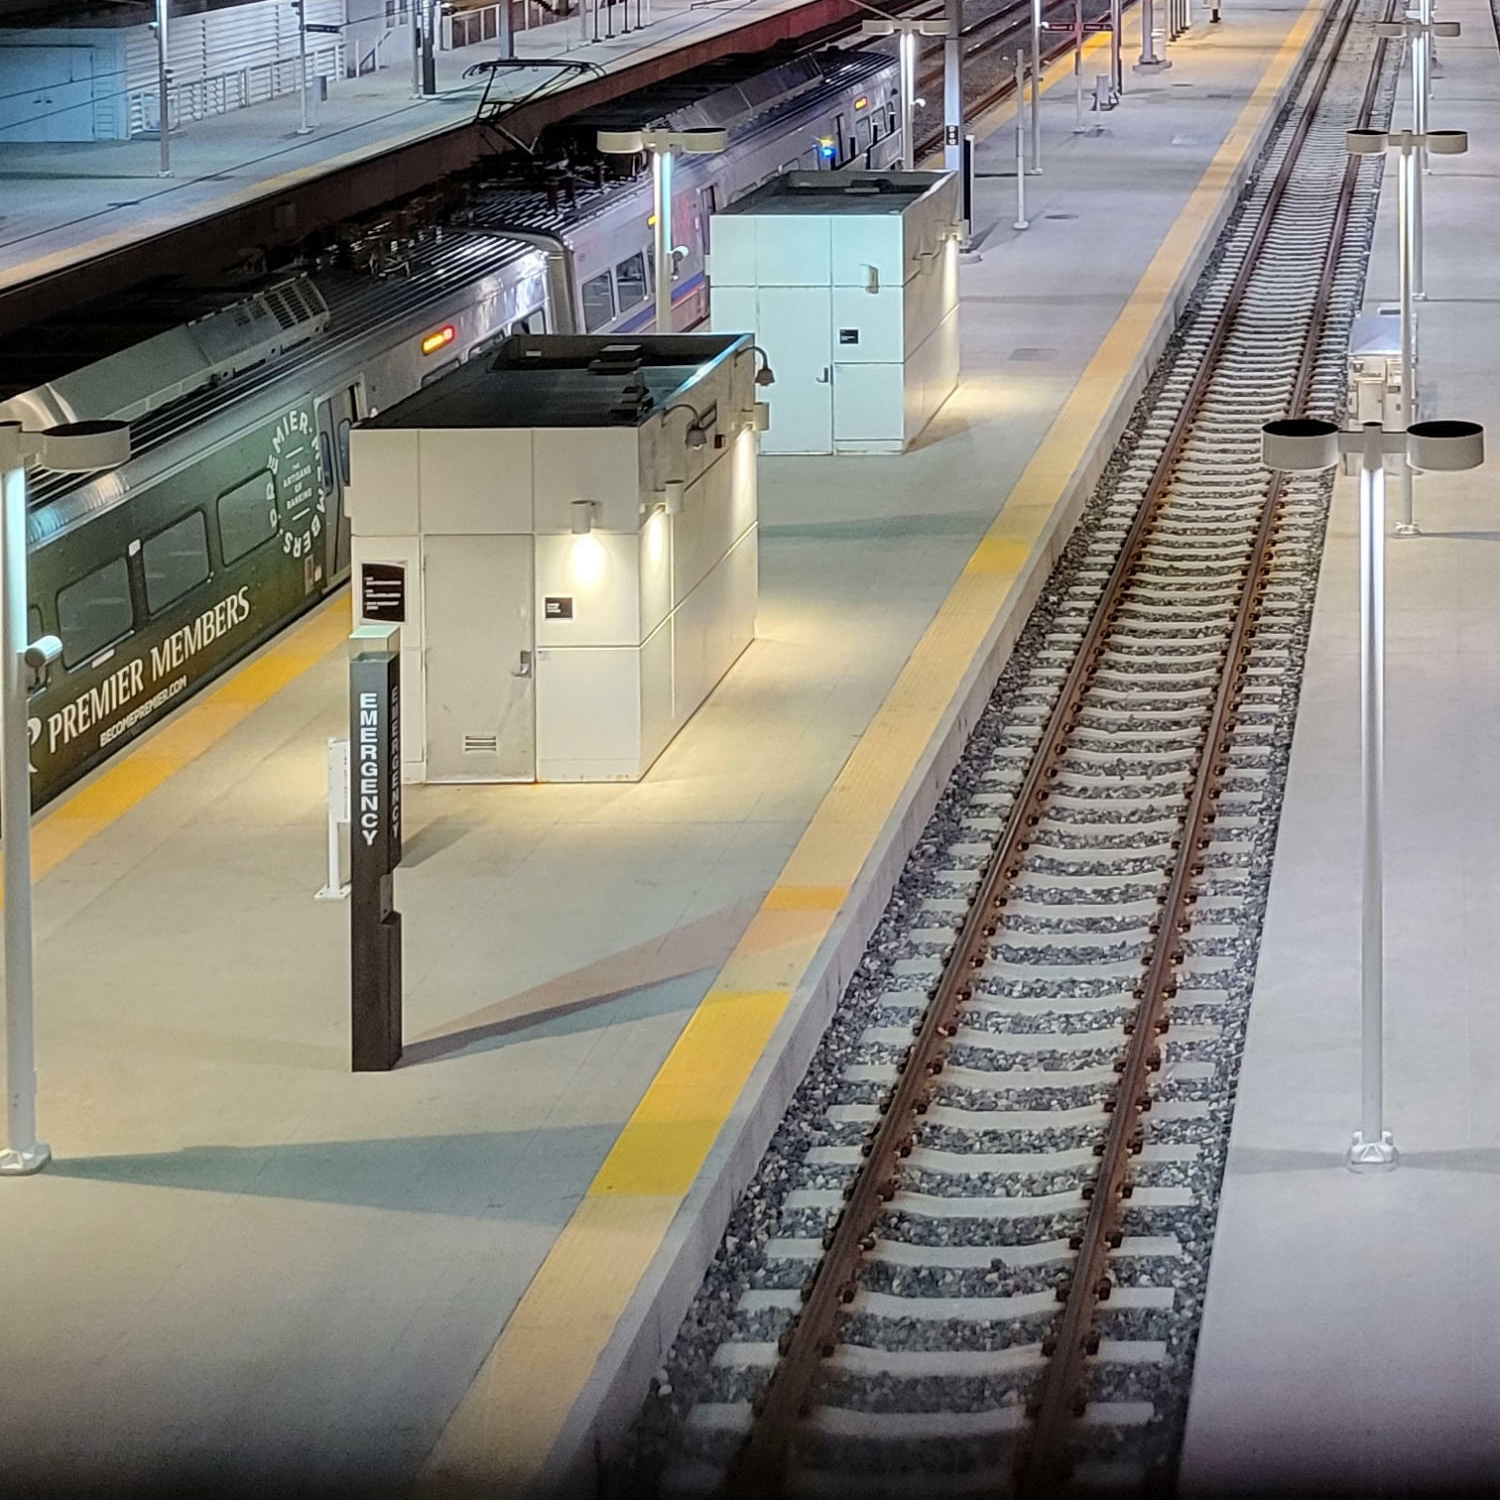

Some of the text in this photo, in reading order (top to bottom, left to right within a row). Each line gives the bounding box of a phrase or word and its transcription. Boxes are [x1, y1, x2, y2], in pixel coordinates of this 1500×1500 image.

[47, 658, 145, 754] PREMIER
[150, 585, 250, 682] MEMBERS
[99, 675, 188, 748] BECOMEPREMIER.COM
[360, 693, 379, 846] EMERGENCY
[391, 686, 400, 839] EMERGENCY
